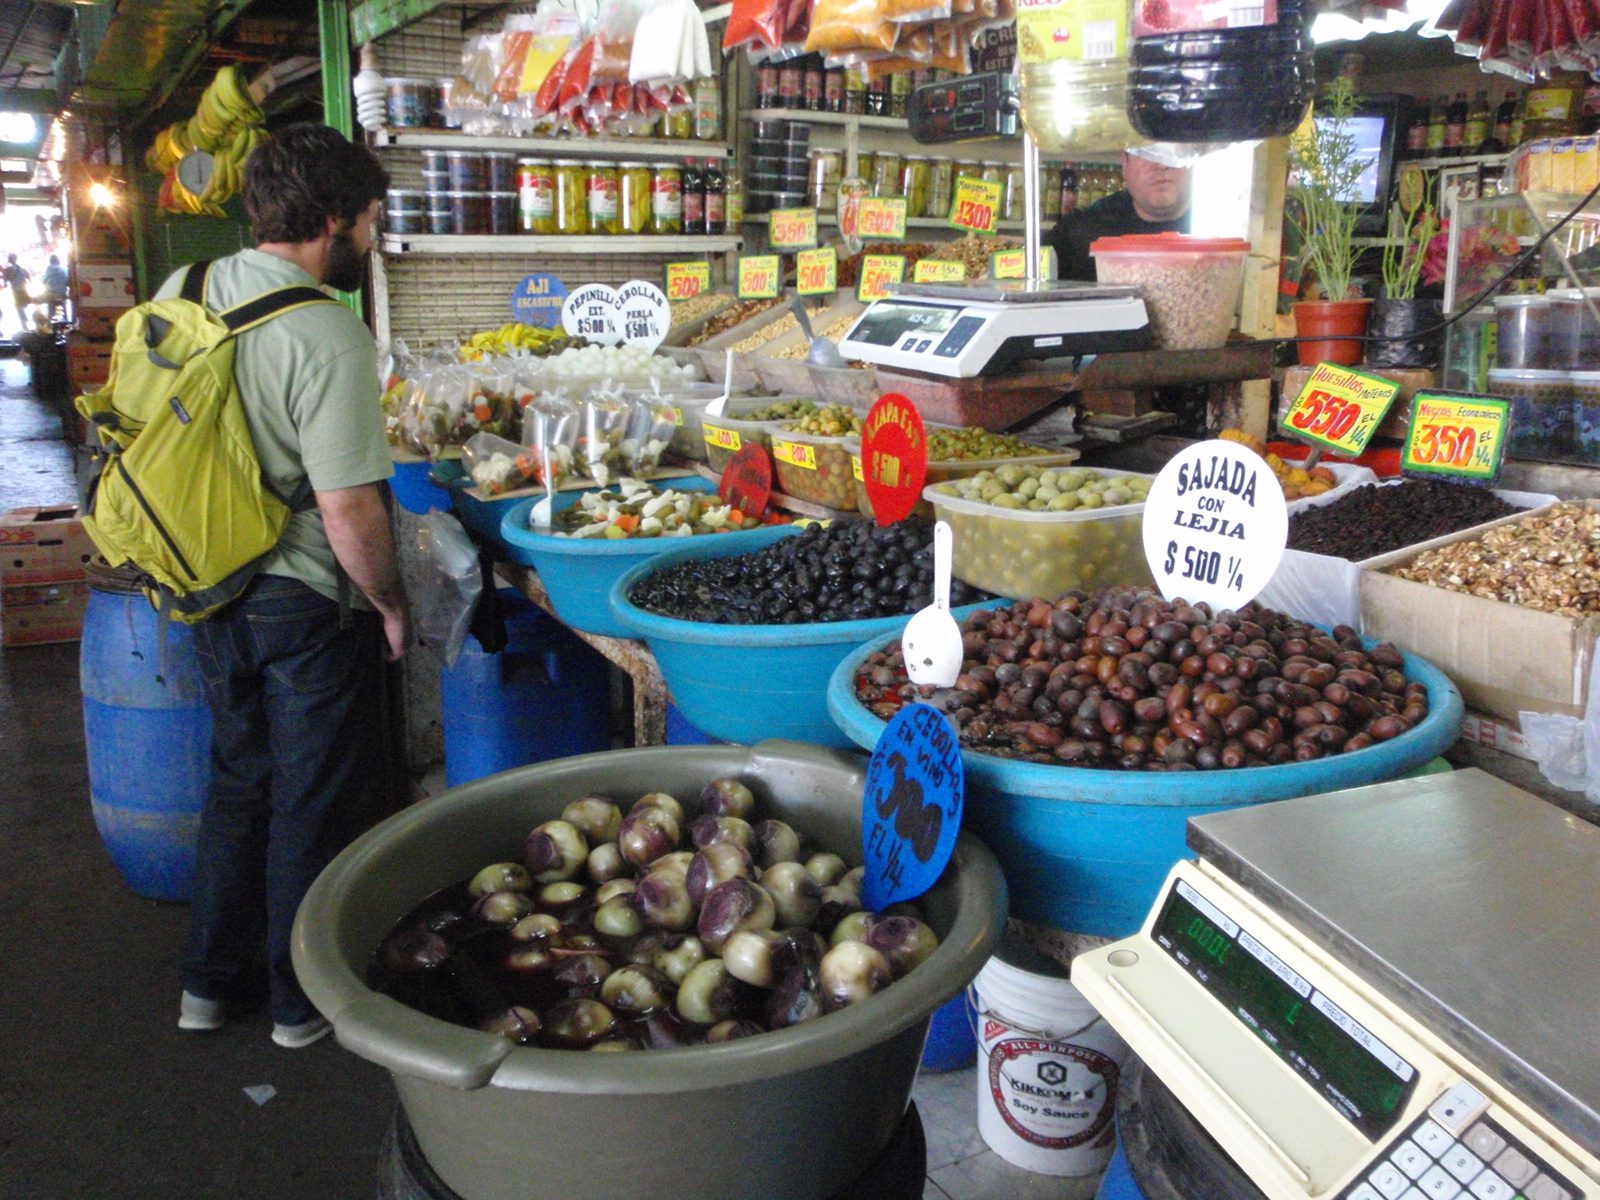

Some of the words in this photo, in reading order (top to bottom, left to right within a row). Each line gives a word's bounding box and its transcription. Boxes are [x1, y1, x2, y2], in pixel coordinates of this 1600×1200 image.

[615, 286, 663, 310] CEBOLLAS
[671, 276, 700, 298] 500
[626, 309, 653, 319] PERLA
[1292, 389, 1361, 441] 550
[1361, 413, 1376, 424] EL
[1413, 424, 1476, 467] 350
[1480, 430, 1493, 443] EL
[1177, 456, 1257, 508] SAJADA
[1198, 496, 1225, 513] CON
[1173, 510, 1246, 541] LEJIA
[1321, 1000, 1348, 1027] PRECIO
[1350, 1021, 1372, 1048] TOTAL
[1013, 1098, 1038, 1115] Soy
[1043, 1107, 1090, 1119] Sauce
